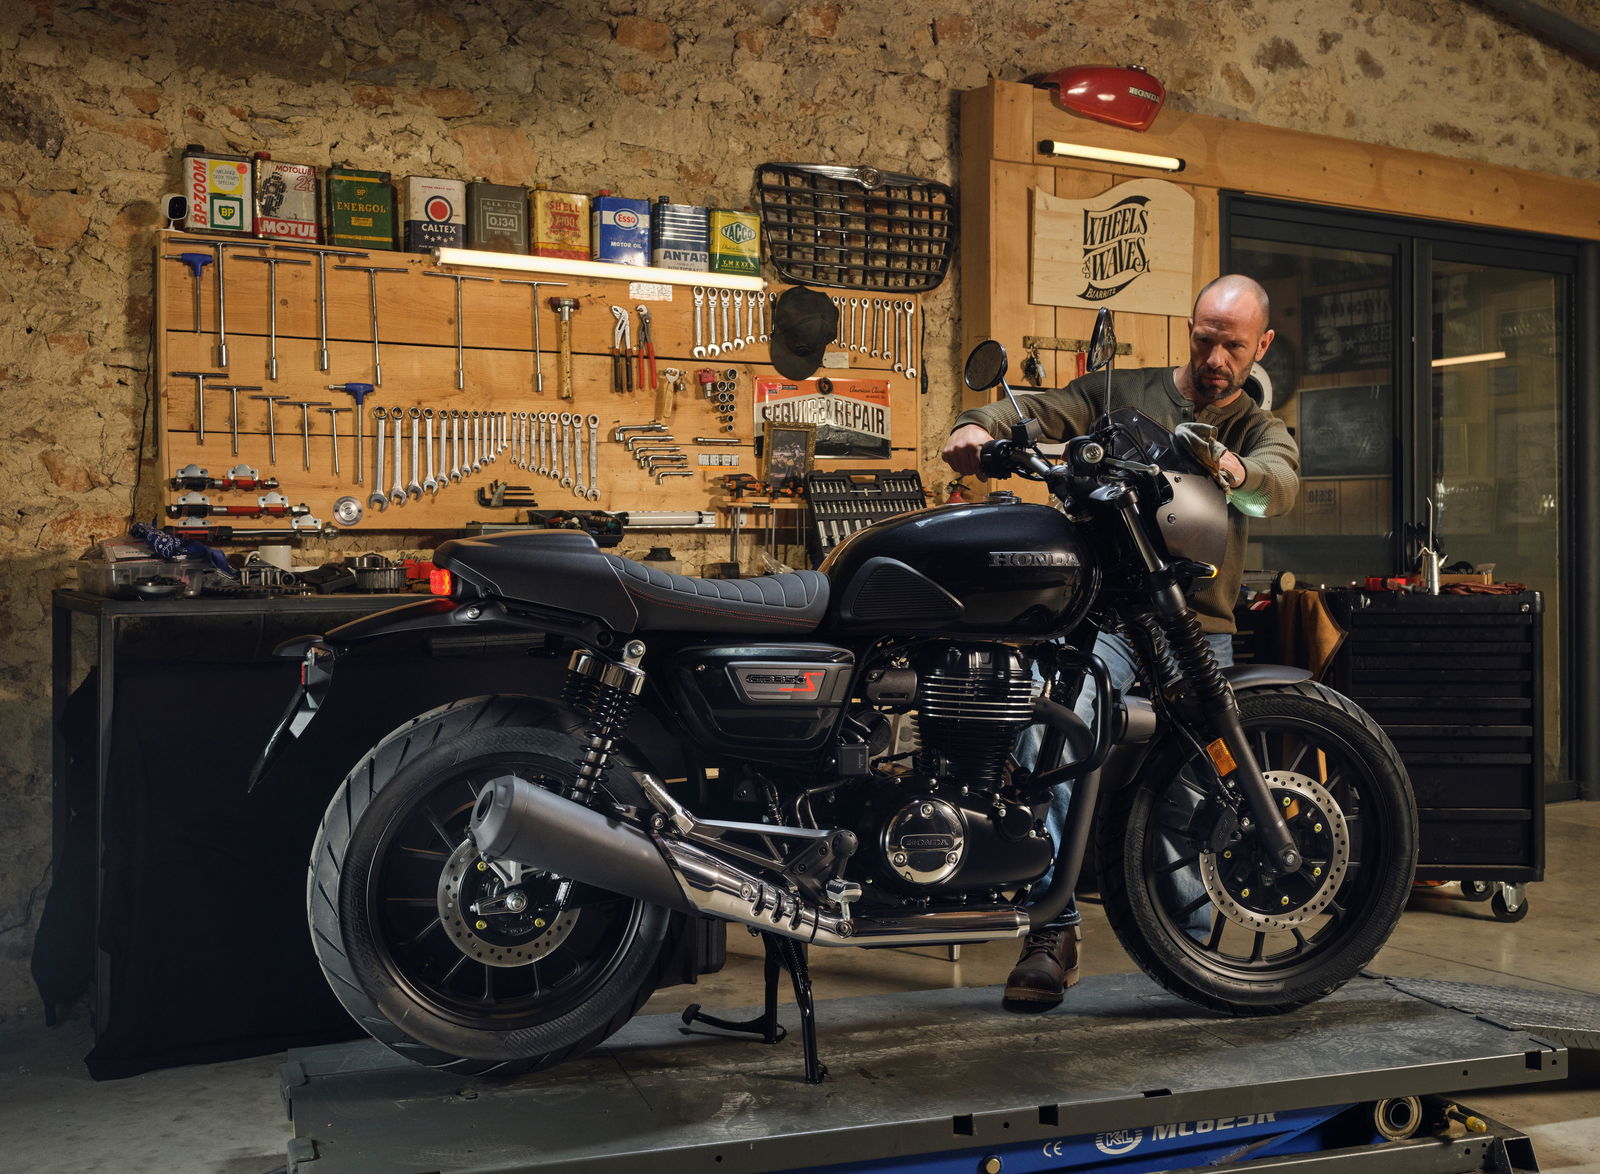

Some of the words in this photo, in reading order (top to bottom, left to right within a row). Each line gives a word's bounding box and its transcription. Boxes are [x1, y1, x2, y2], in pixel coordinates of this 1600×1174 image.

[1128, 86, 1160, 103] HONDA
[221, 207, 234, 217] BP
[336, 201, 387, 214] ENERGOL
[549, 200, 580, 213] SHELL
[262, 220, 317, 238] MOTUL
[421, 223, 457, 234] CALTEX
[724, 223, 753, 242] YACCO
[1083, 208, 1149, 246] WHEELS
[610, 241, 632, 249] MOTOR
[663, 250, 708, 263] ANTAR
[1092, 237, 1148, 281] WAVES
[1087, 287, 1117, 299] BIARRITZ
[833, 397, 885, 435] REPAIR
[989, 551, 1081, 567] HONDA
[905, 839, 949, 847] HONDA
